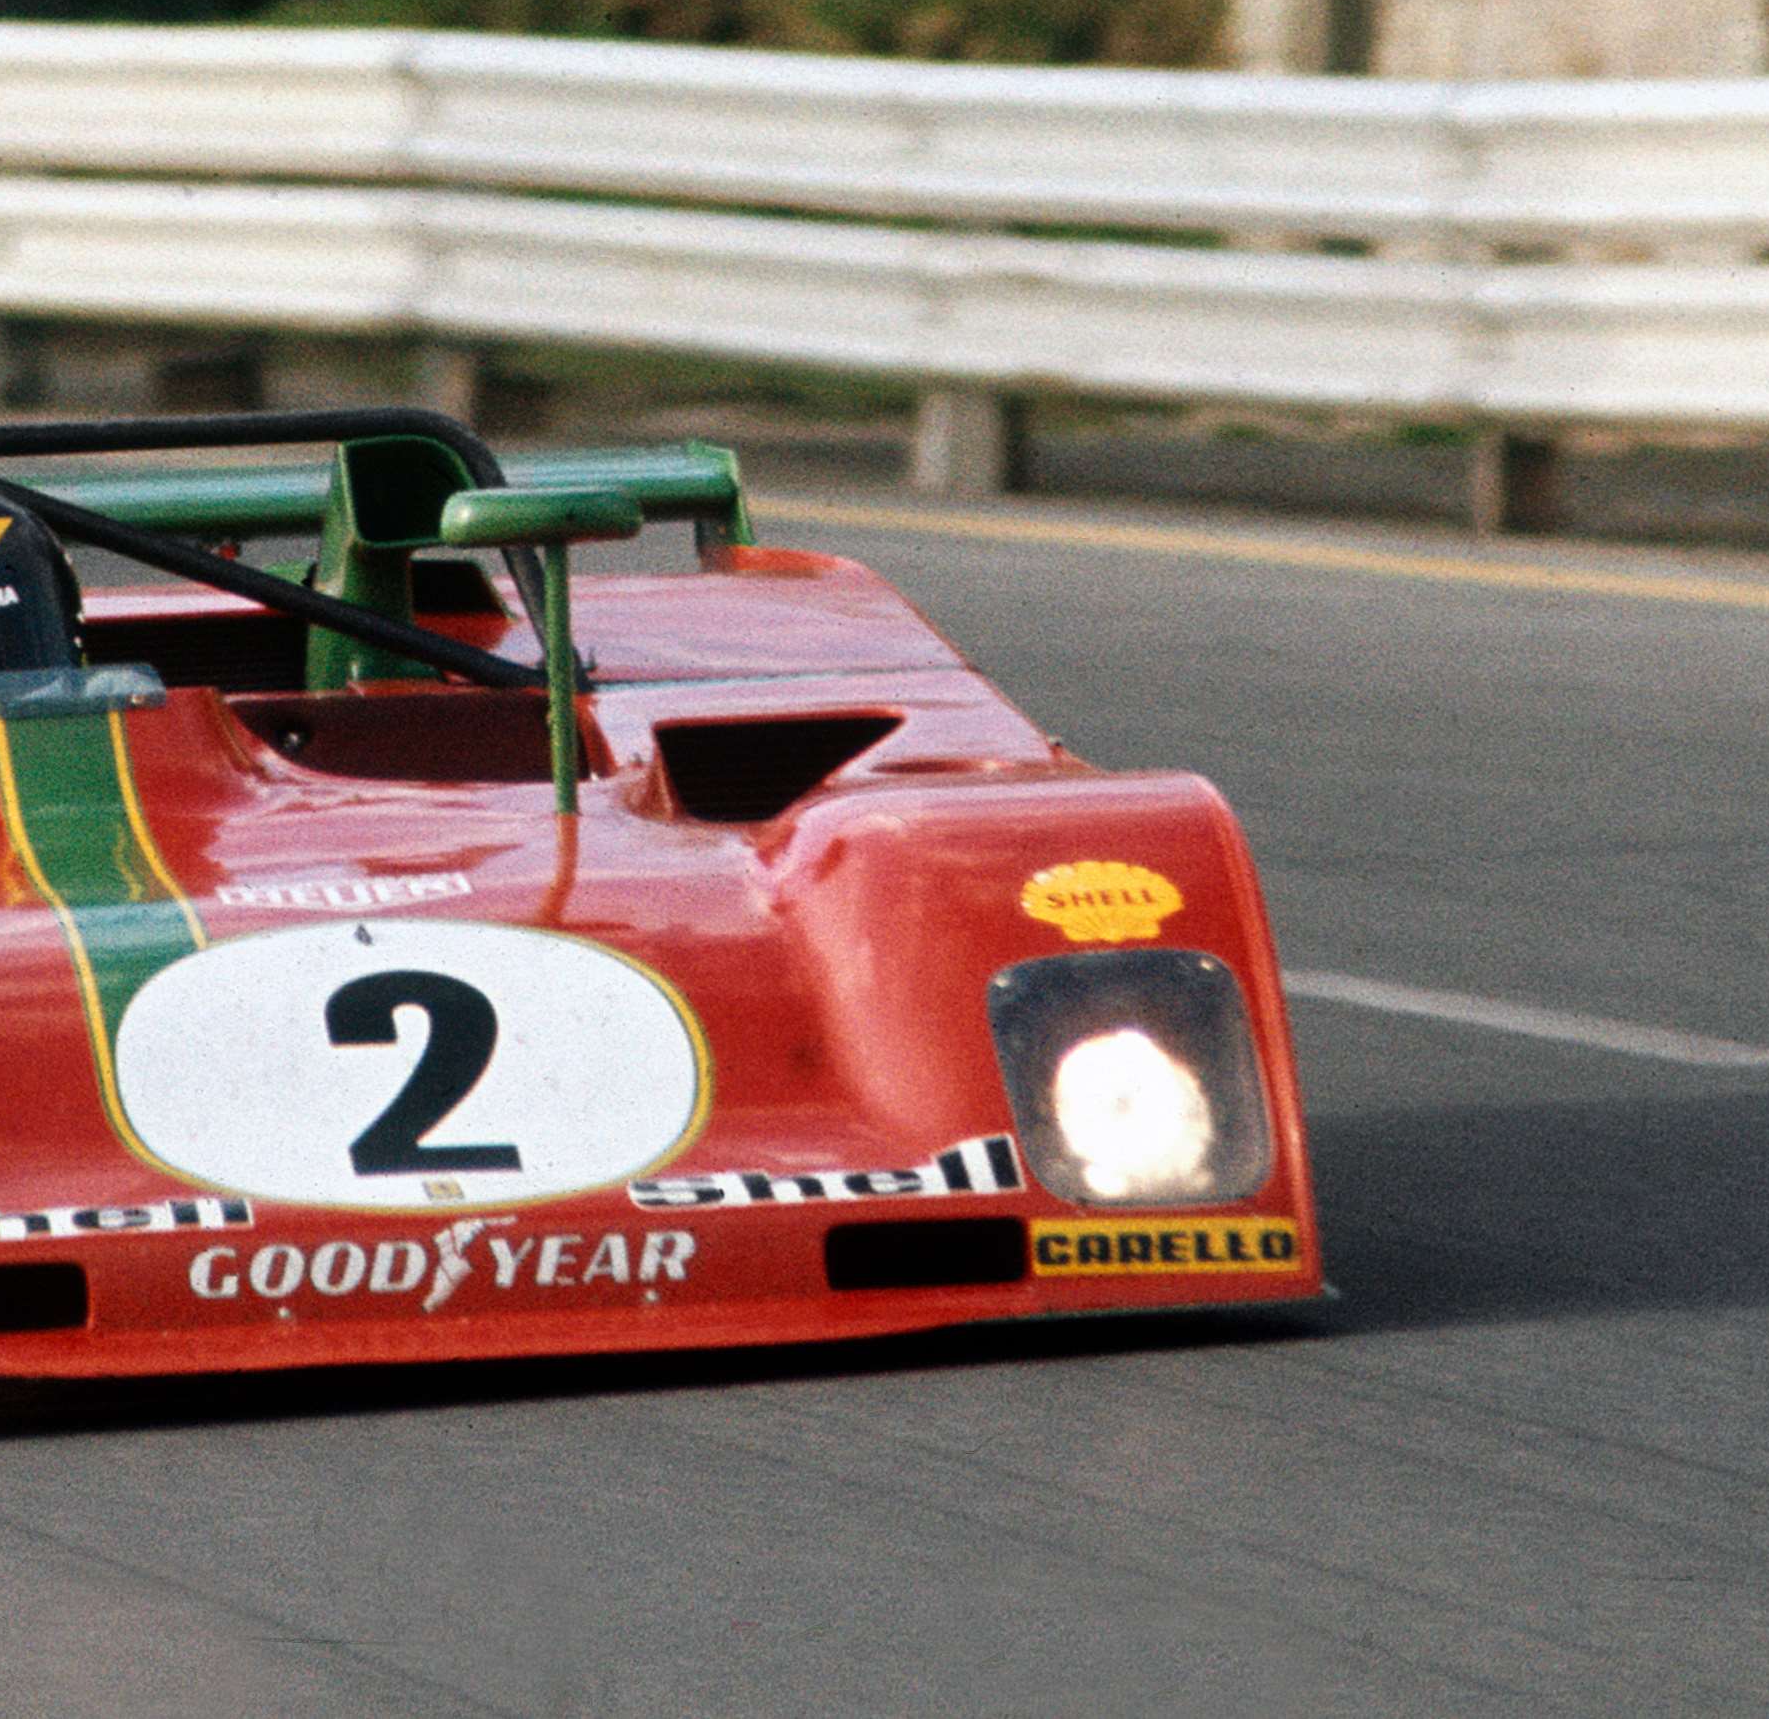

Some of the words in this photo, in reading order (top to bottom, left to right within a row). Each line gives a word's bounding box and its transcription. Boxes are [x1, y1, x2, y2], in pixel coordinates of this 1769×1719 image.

[1045, 886, 1156, 910] SHELL
[324, 968, 524, 1177] 2
[631, 1136, 1023, 1207] Shell
[1035, 1228, 1294, 1266] CARELLO
